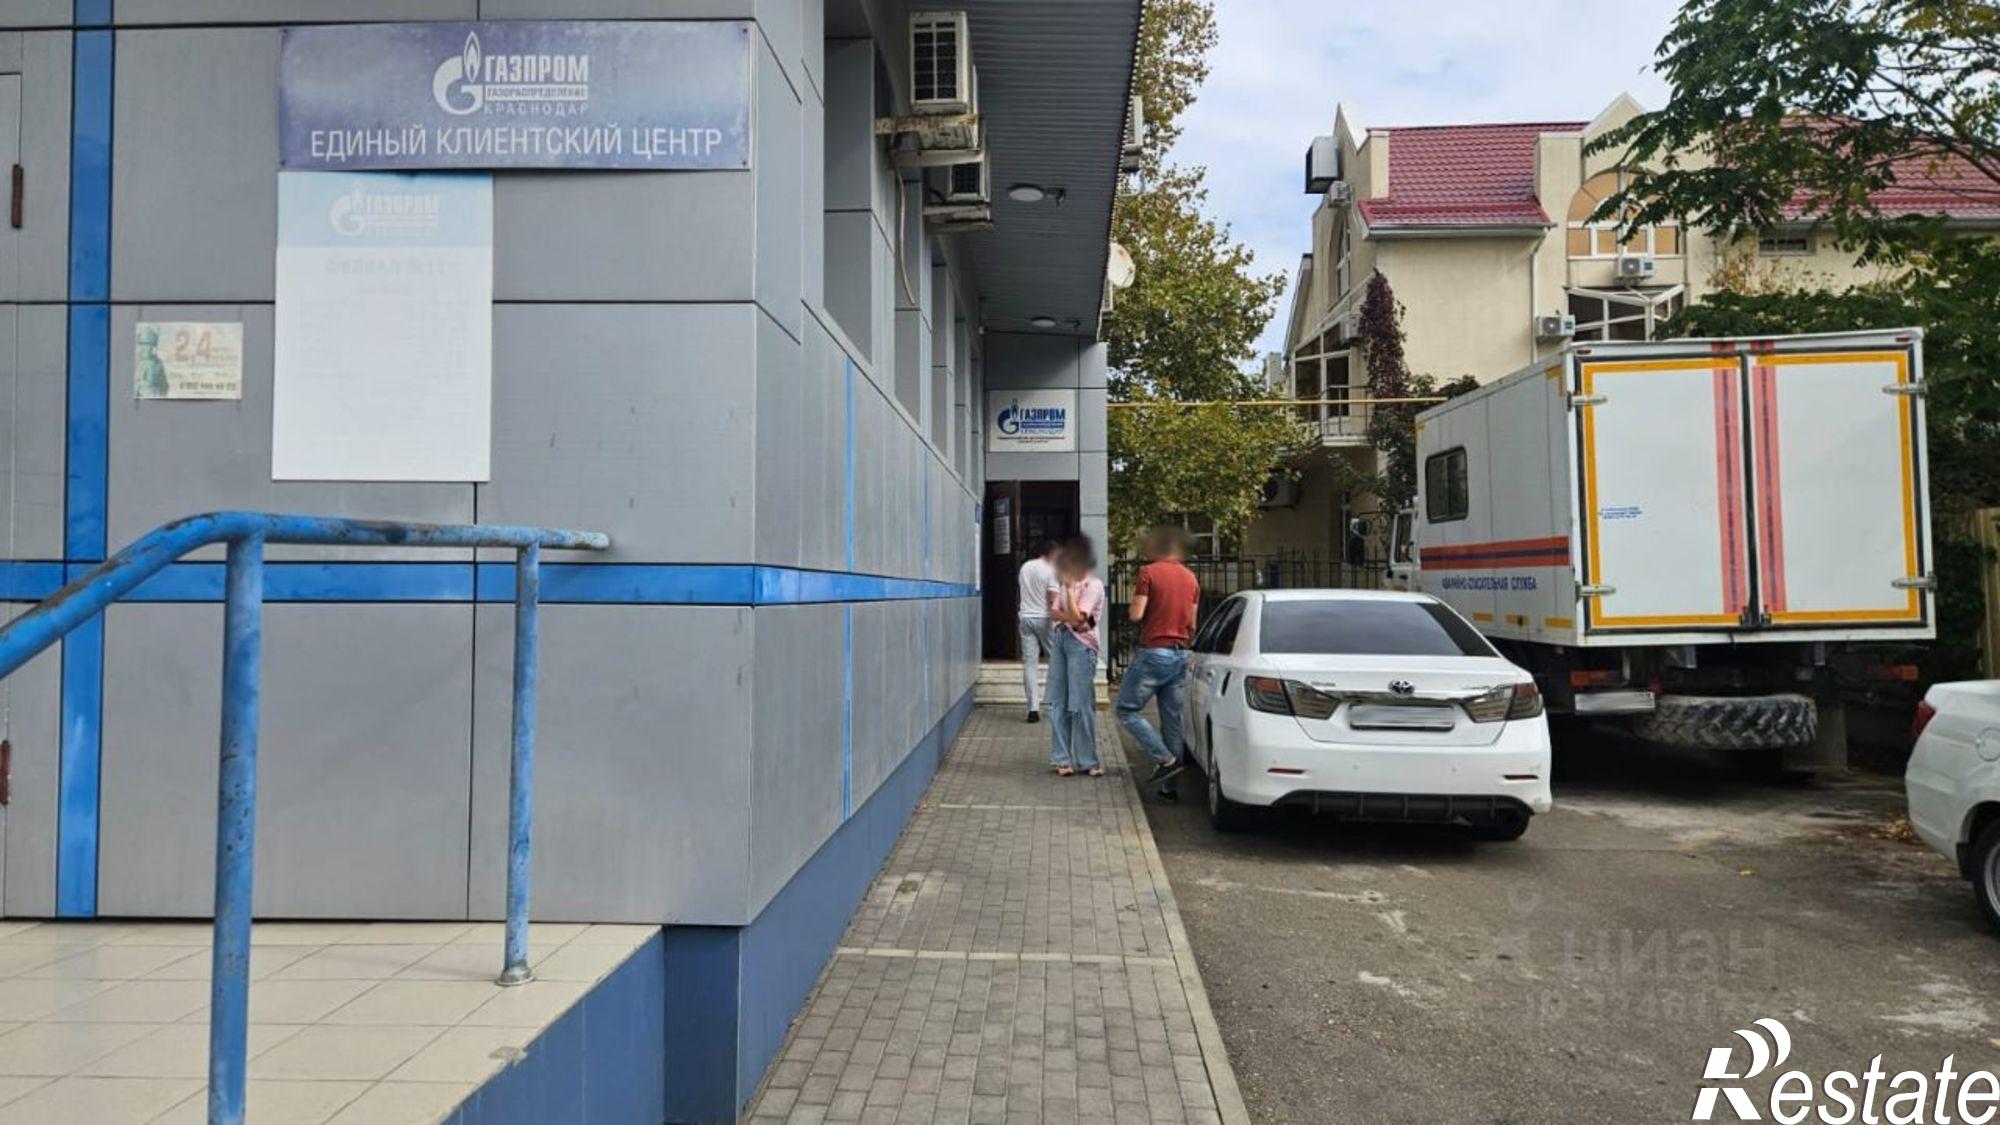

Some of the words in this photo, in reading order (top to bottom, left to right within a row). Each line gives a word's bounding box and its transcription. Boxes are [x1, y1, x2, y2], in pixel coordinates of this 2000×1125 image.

[485, 55, 589, 82] ГАЗПРОМ
[483, 102, 589, 116] КРАСНОДАР
[311, 124, 426, 161] ЕДИНЫЙ
[436, 123, 622, 157] КЛИЕНТСКИЙ
[633, 128, 722, 160] ЦЕНТР
[1019, 407, 1066, 421] ГАЗПРОМ
